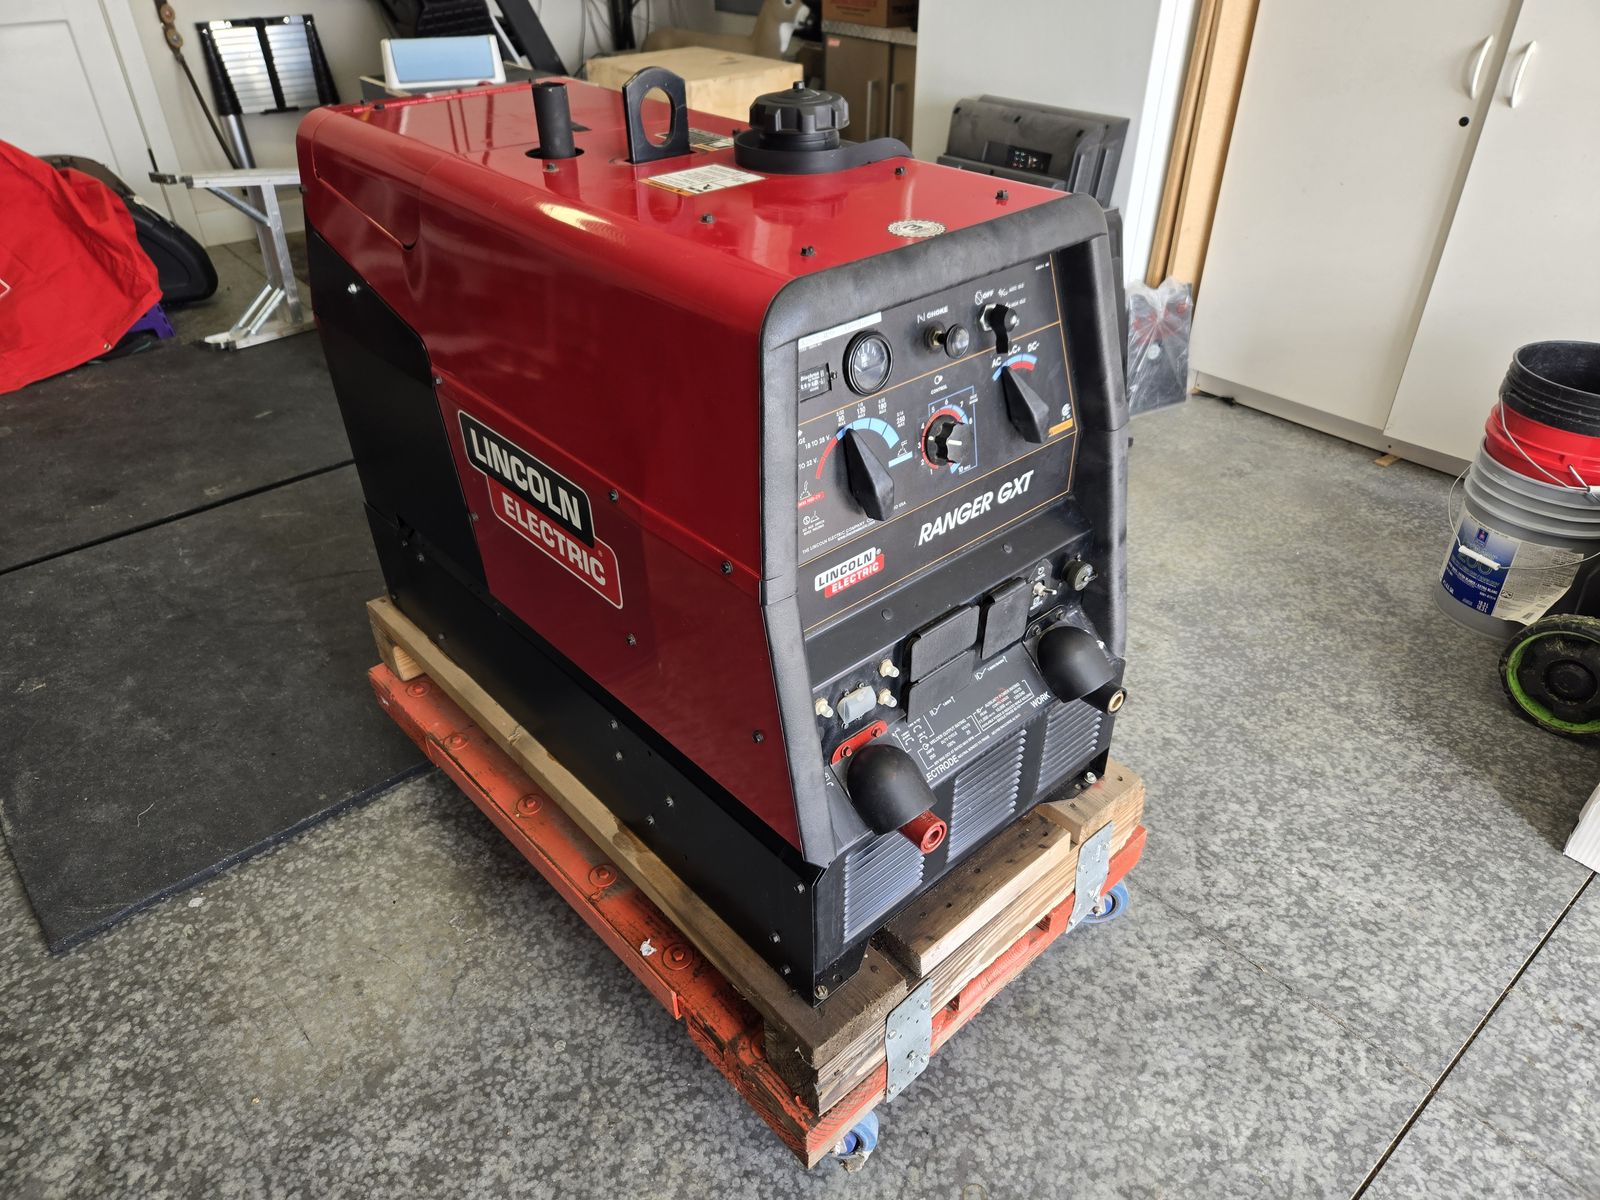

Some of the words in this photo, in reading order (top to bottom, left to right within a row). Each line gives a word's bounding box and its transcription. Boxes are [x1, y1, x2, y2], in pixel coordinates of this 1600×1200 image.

[982, 289, 994, 300] OFF
[926, 305, 948, 318] CHOKE
[992, 356, 1002, 368] AC
[930, 384, 948, 395] CONTROL
[805, 442, 811, 450] 18
[811, 439, 819, 448] TO
[806, 459, 813, 467] 22
[470, 428, 582, 530] LINCOLN
[918, 491, 994, 546] RANGER
[997, 470, 1034, 504] GXT
[502, 492, 606, 586] ELECTRIC
[810, 538, 828, 551] LINCOLN
[828, 530, 845, 543] ELECTRIC
[845, 521, 865, 536] COMPANY
[818, 552, 872, 587] LINCOLN
[831, 561, 880, 593] ELECTRIC
[1030, 691, 1051, 708] WORK
[929, 734, 942, 744] WELDER
[942, 726, 954, 736] OUTPUT
[954, 718, 966, 727] RATING
[926, 755, 959, 783] ECTRODE
